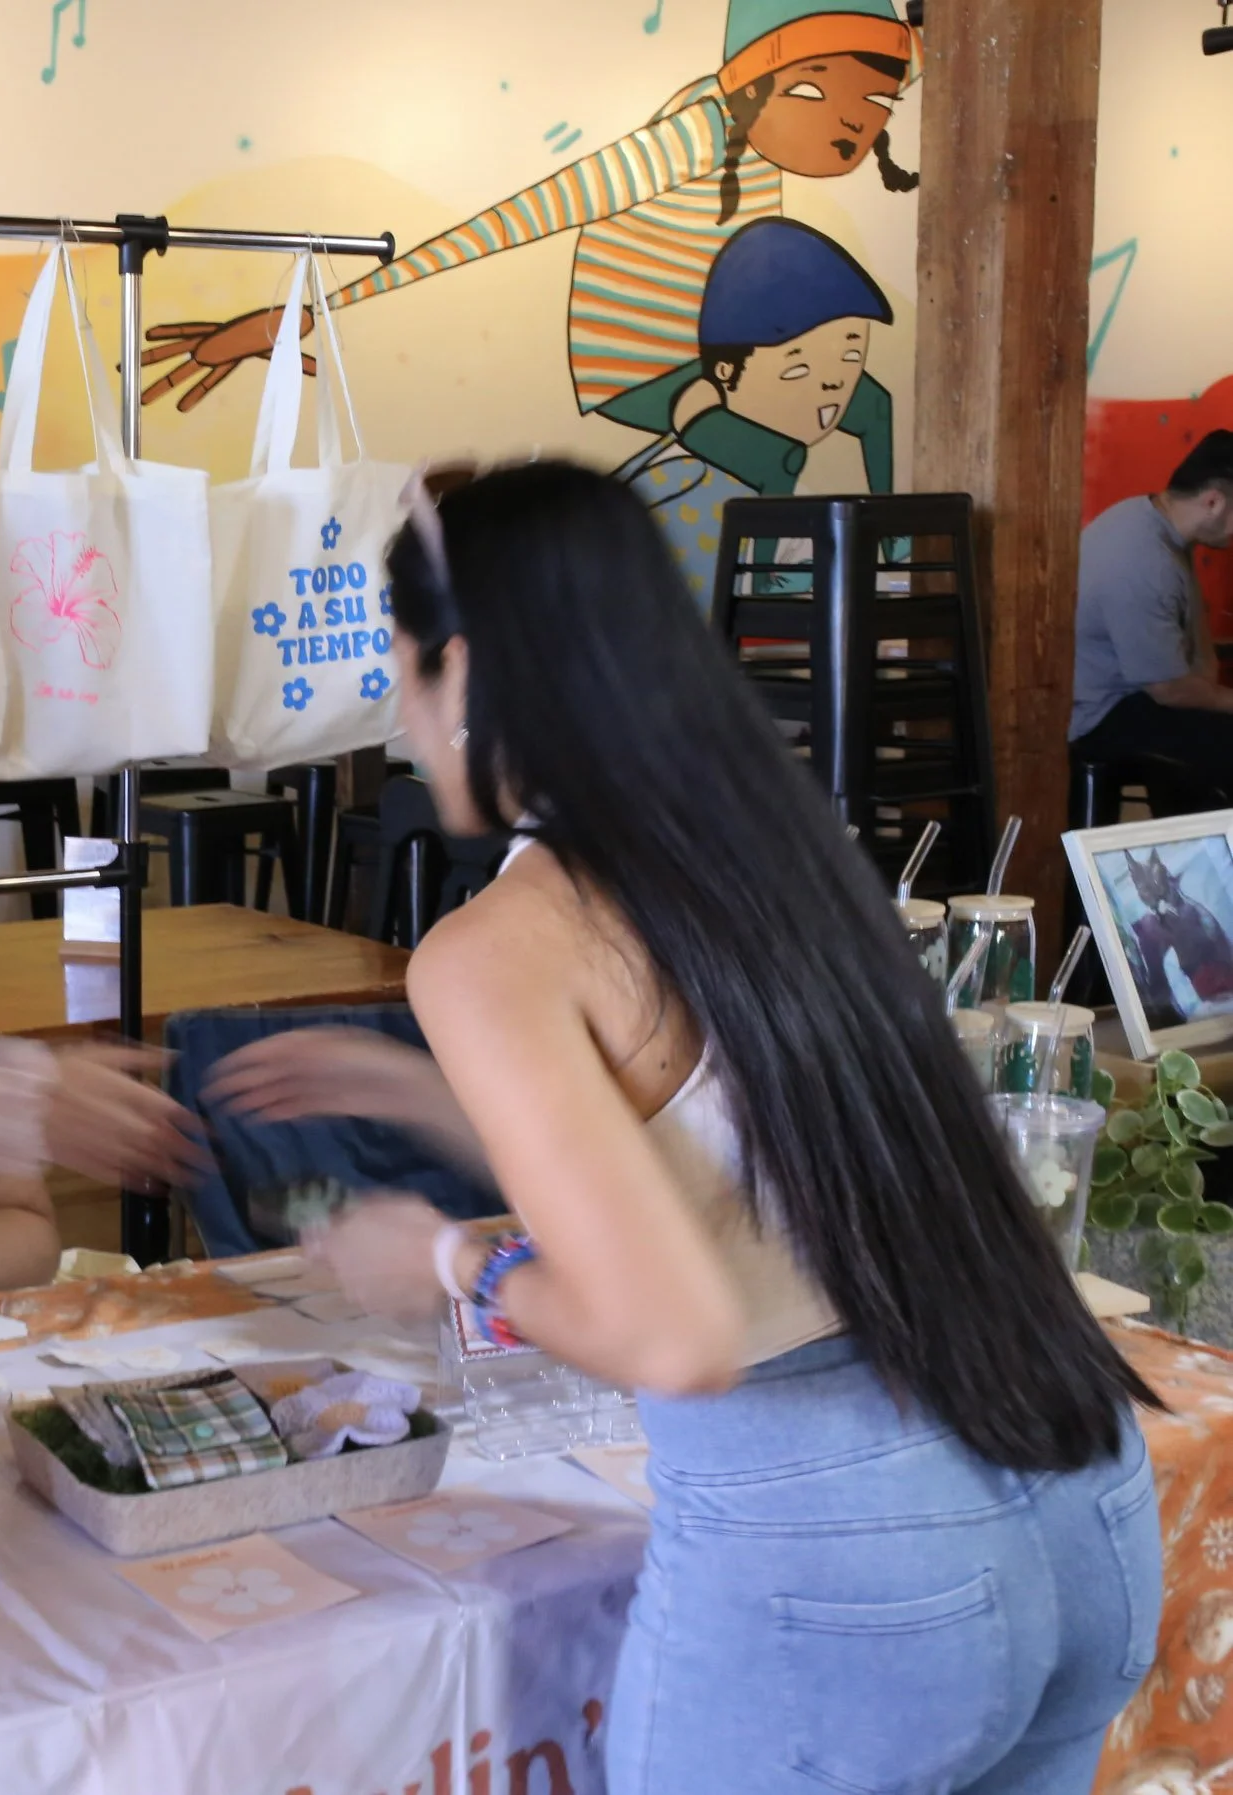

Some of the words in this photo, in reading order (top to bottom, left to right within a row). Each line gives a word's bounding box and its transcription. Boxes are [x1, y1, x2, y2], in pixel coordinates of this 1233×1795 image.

[289, 562, 367, 596] TODO
[298, 602, 317, 630] A
[324, 596, 367, 627] SU
[276, 628, 392, 667] TIEMPO
